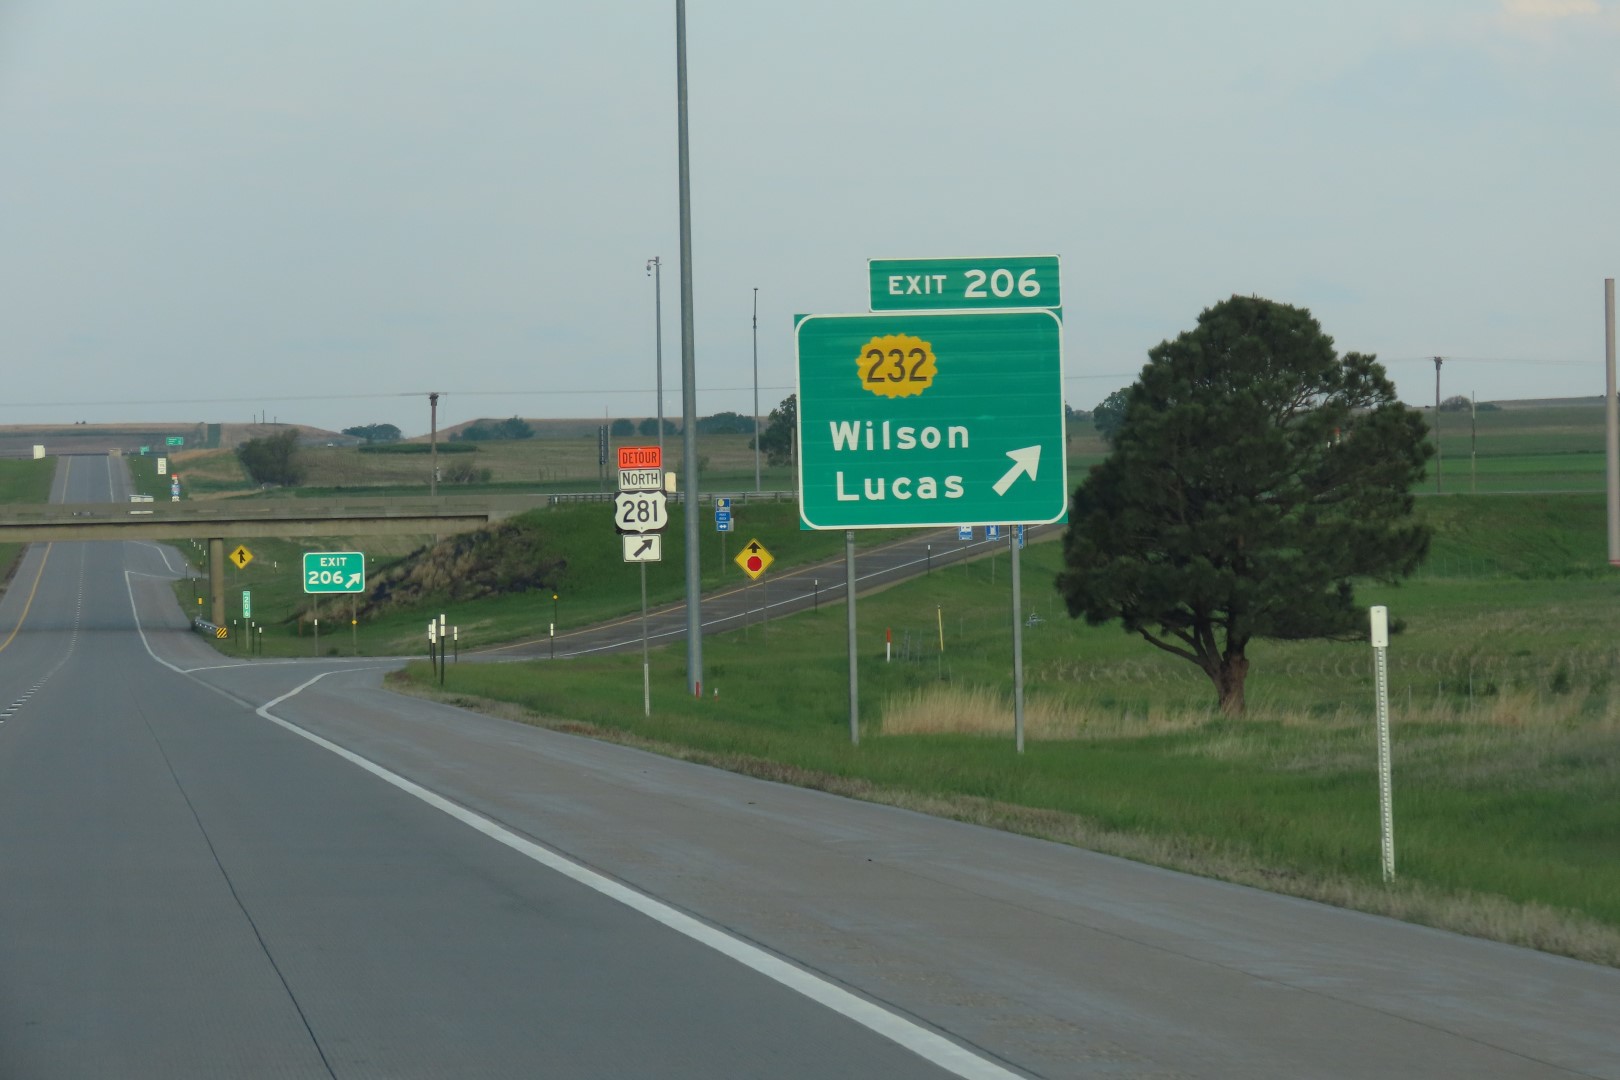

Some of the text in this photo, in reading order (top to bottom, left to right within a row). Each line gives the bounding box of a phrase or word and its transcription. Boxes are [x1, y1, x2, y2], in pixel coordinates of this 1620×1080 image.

[888, 268, 1041, 298] EXIT 206
[866, 347, 928, 383] 232
[829, 420, 969, 451] Wilson
[622, 451, 657, 464] DETOUR
[622, 472, 658, 486] NORTH
[836, 471, 965, 501] Lucas
[622, 500, 658, 523] 281
[320, 557, 348, 567] EXIT
[308, 570, 344, 585] 206
